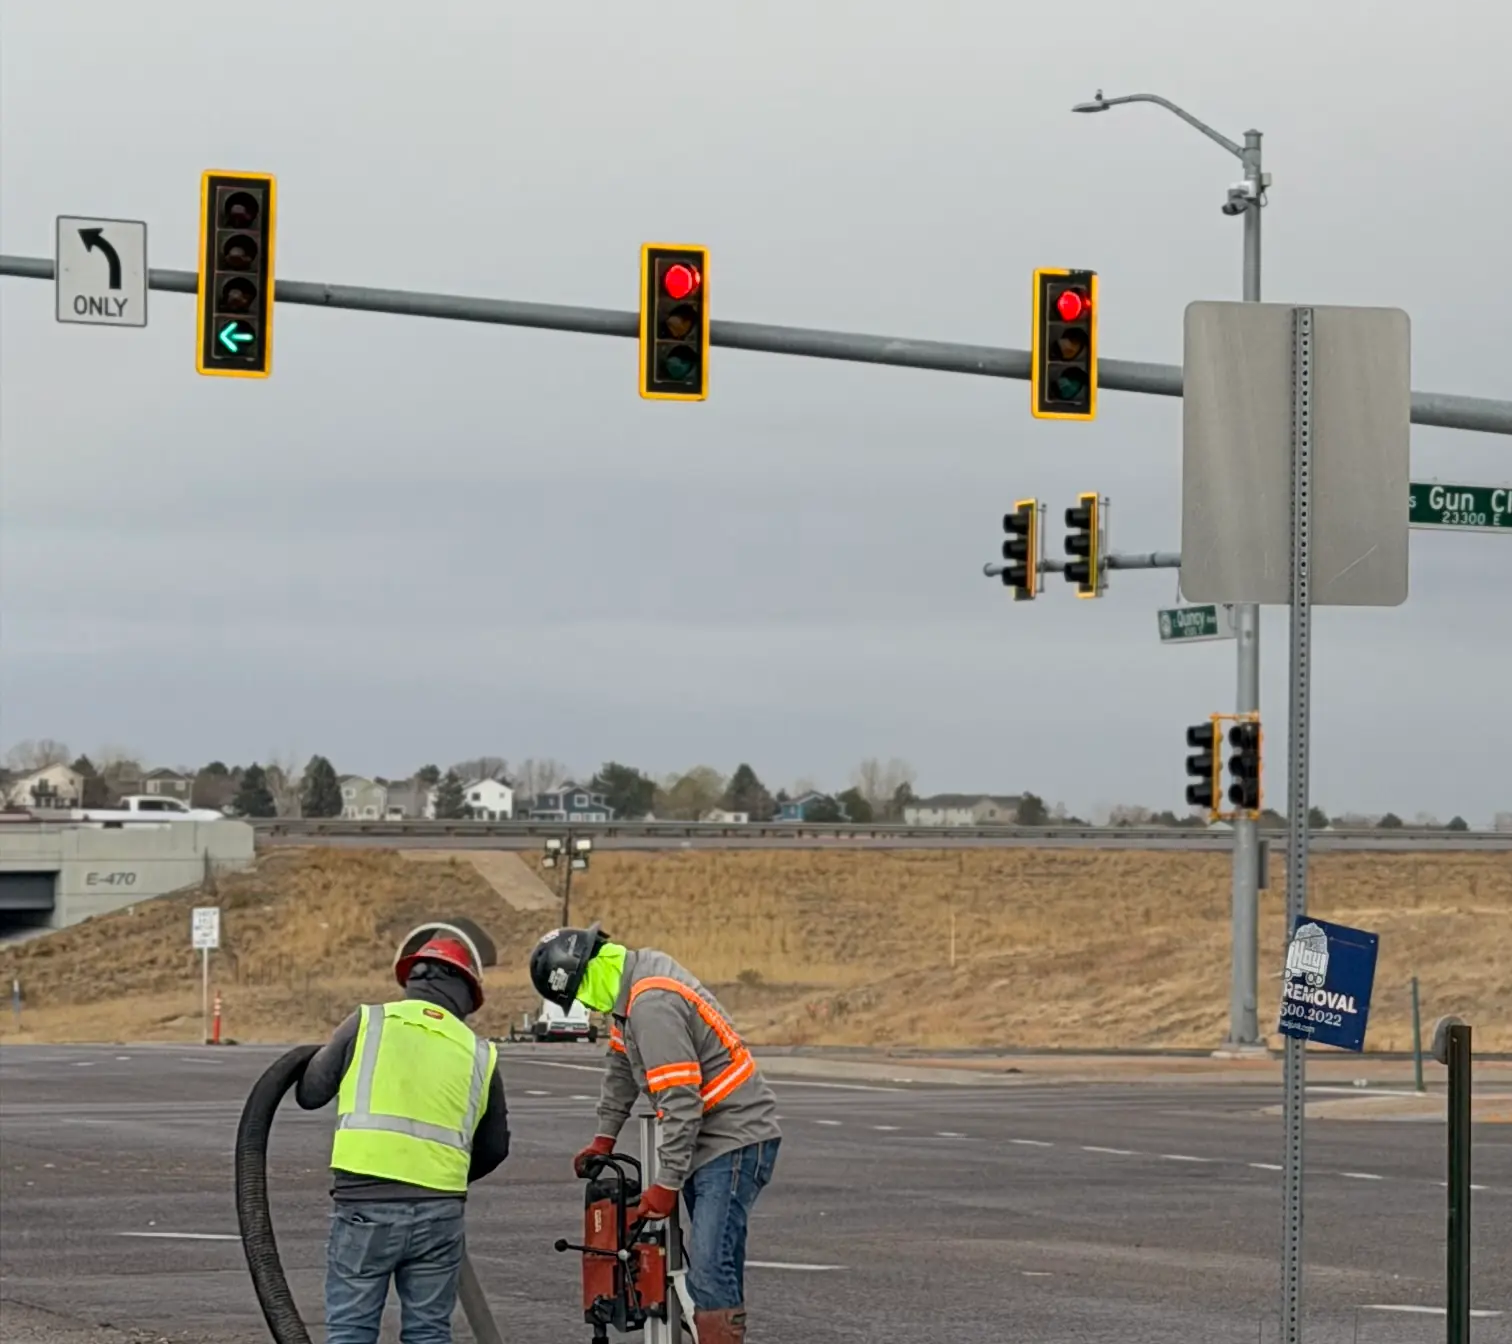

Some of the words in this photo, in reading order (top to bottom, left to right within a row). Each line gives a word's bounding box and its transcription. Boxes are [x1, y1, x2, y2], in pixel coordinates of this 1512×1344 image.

[73, 294, 128, 317] ONLY
[1429, 486, 1474, 511] Gun
[1442, 511, 1486, 526] 23300
[1493, 514, 1502, 526] E
[87, 872, 136, 885] E-470
[1284, 981, 1358, 1014] REMOVAL
